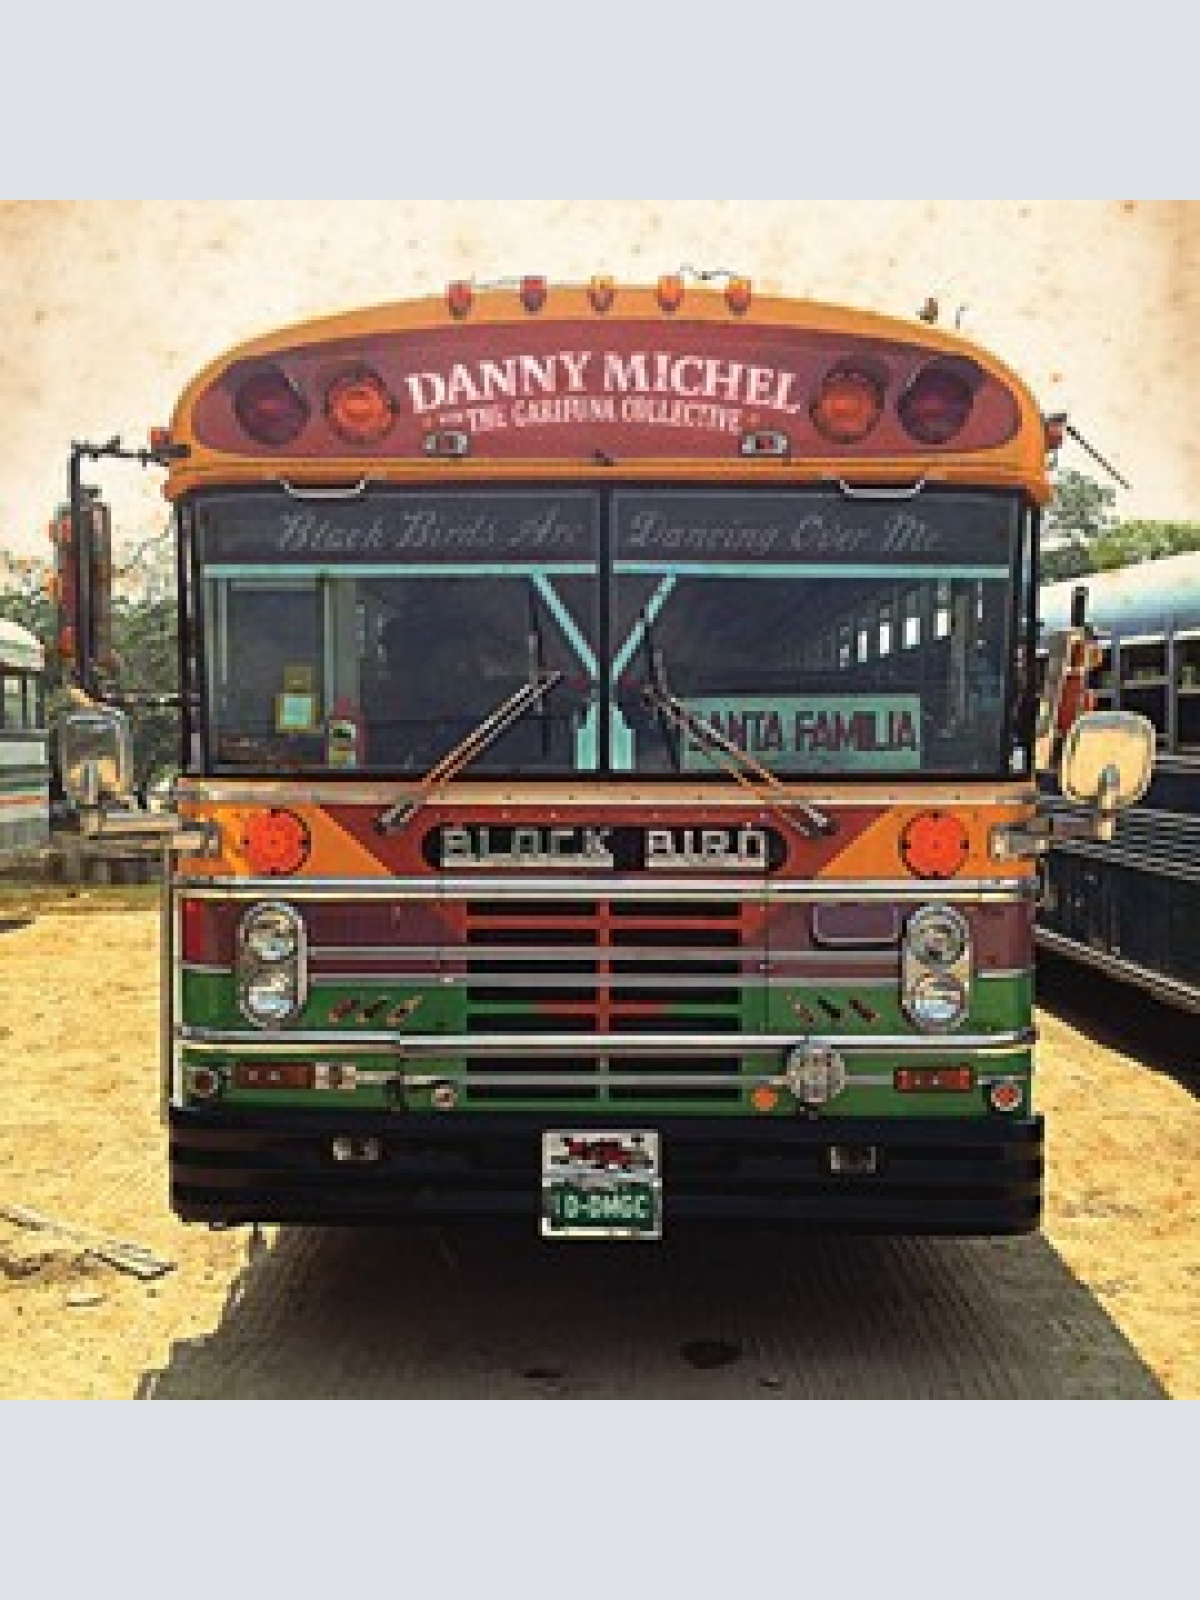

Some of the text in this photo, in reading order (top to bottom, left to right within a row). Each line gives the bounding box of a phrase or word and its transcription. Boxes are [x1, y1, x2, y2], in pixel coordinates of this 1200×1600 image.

[404, 350, 801, 414] DANNY MICHEL
[278, 511, 385, 551] Black
[441, 829, 766, 868] BLACK BIRD
